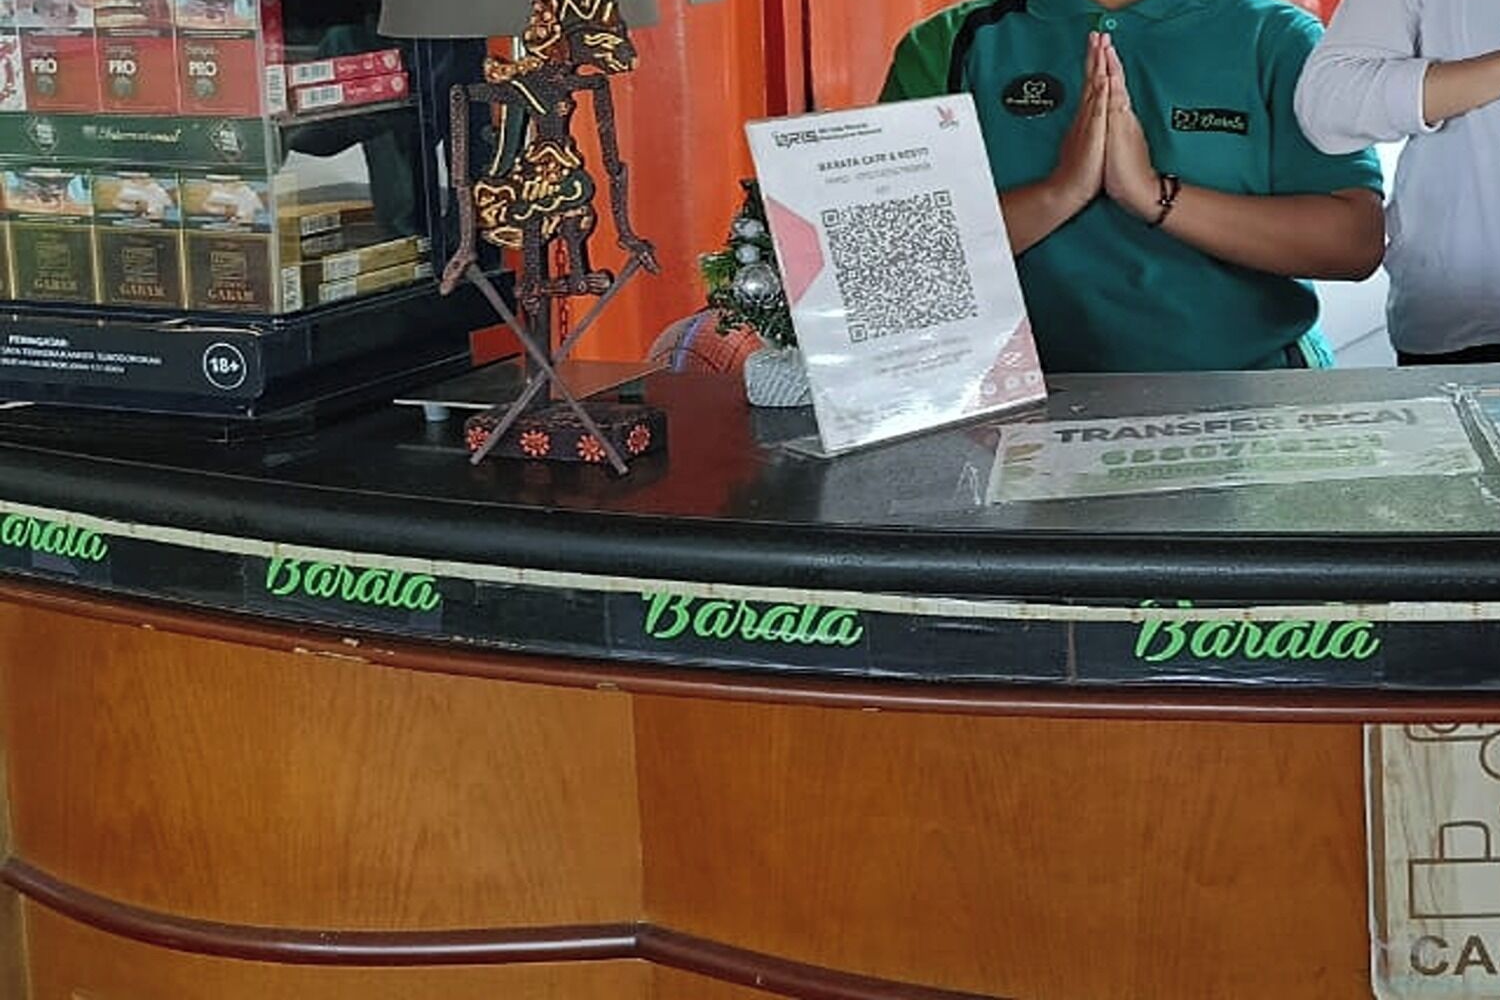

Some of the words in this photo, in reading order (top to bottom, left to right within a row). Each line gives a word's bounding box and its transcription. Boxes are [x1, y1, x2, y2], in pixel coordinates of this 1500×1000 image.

[30, 58, 57, 74] PRO
[109, 59, 136, 75] PRO
[188, 60, 217, 77] PRO
[209, 357, 240, 373] 18+
[266, 556, 440, 611] Barata
[641, 588, 863, 646] Barata
[1133, 606, 1381, 661] Barata
